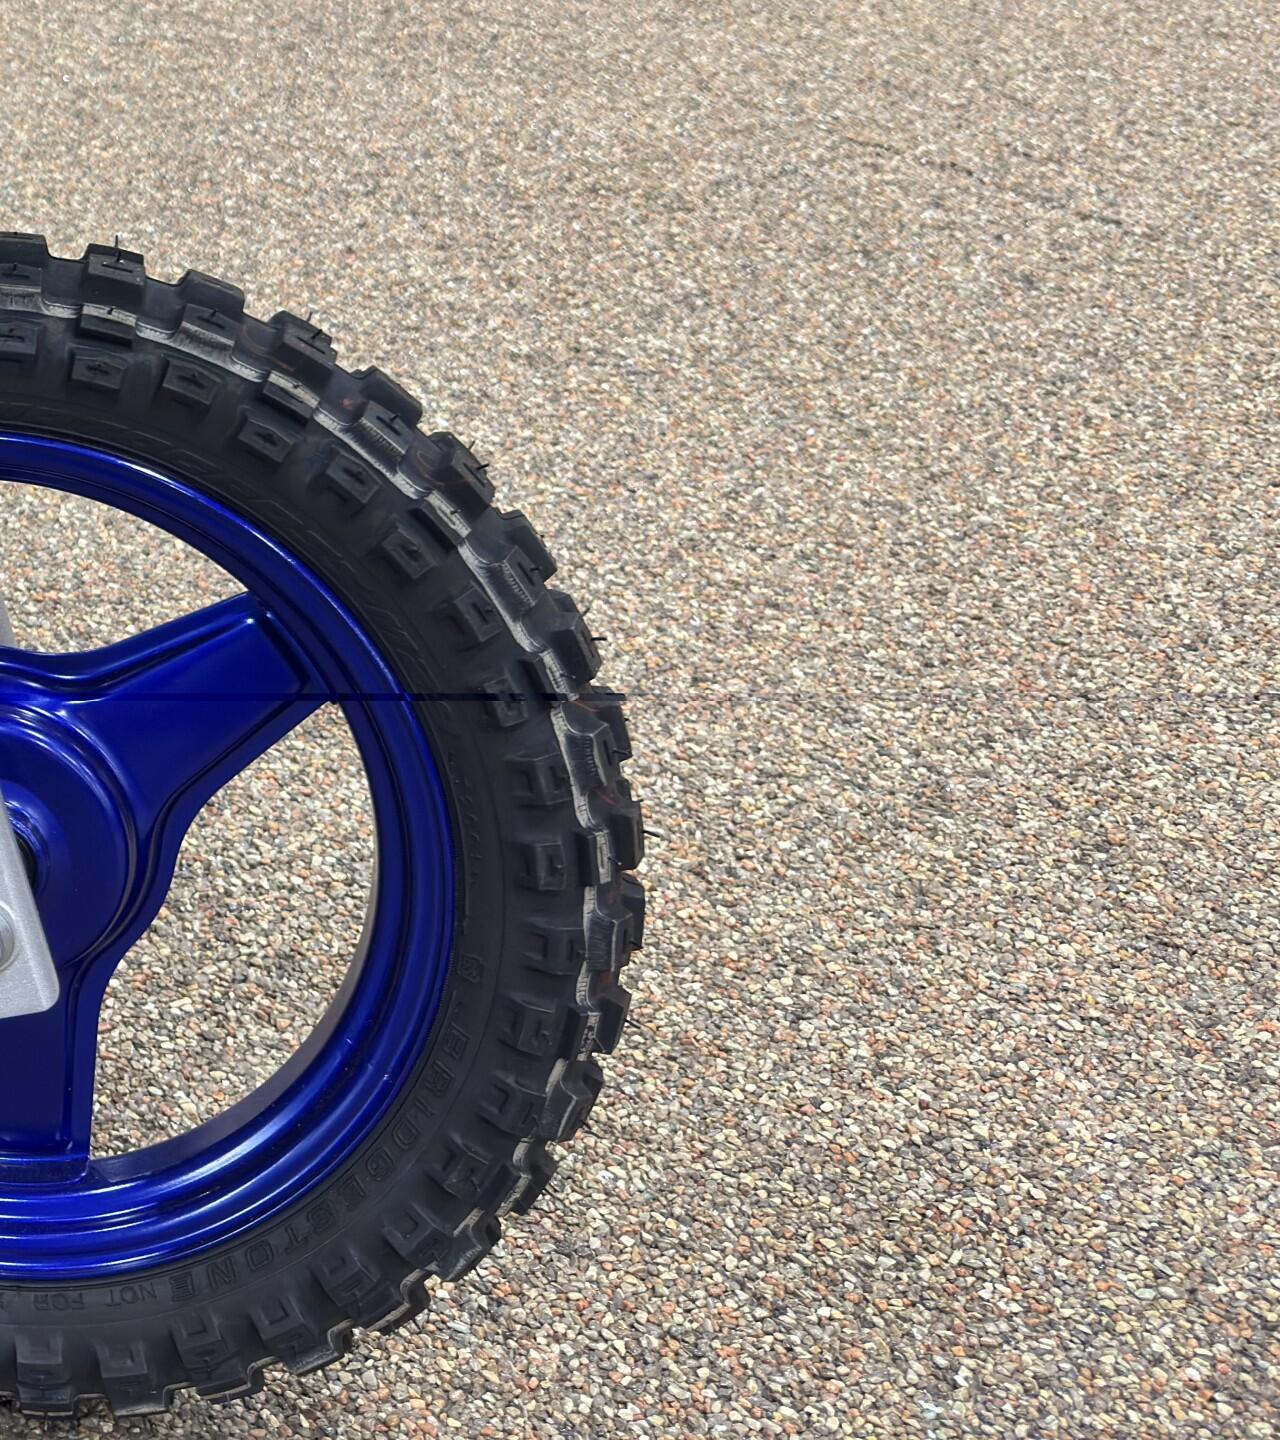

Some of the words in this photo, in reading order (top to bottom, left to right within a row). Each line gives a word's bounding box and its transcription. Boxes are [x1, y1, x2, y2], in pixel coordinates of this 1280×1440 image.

[164, 1021, 472, 1303] BRIDGESTONE
[32, 1293, 84, 1311] FOR
[103, 1282, 158, 1307] NOT
